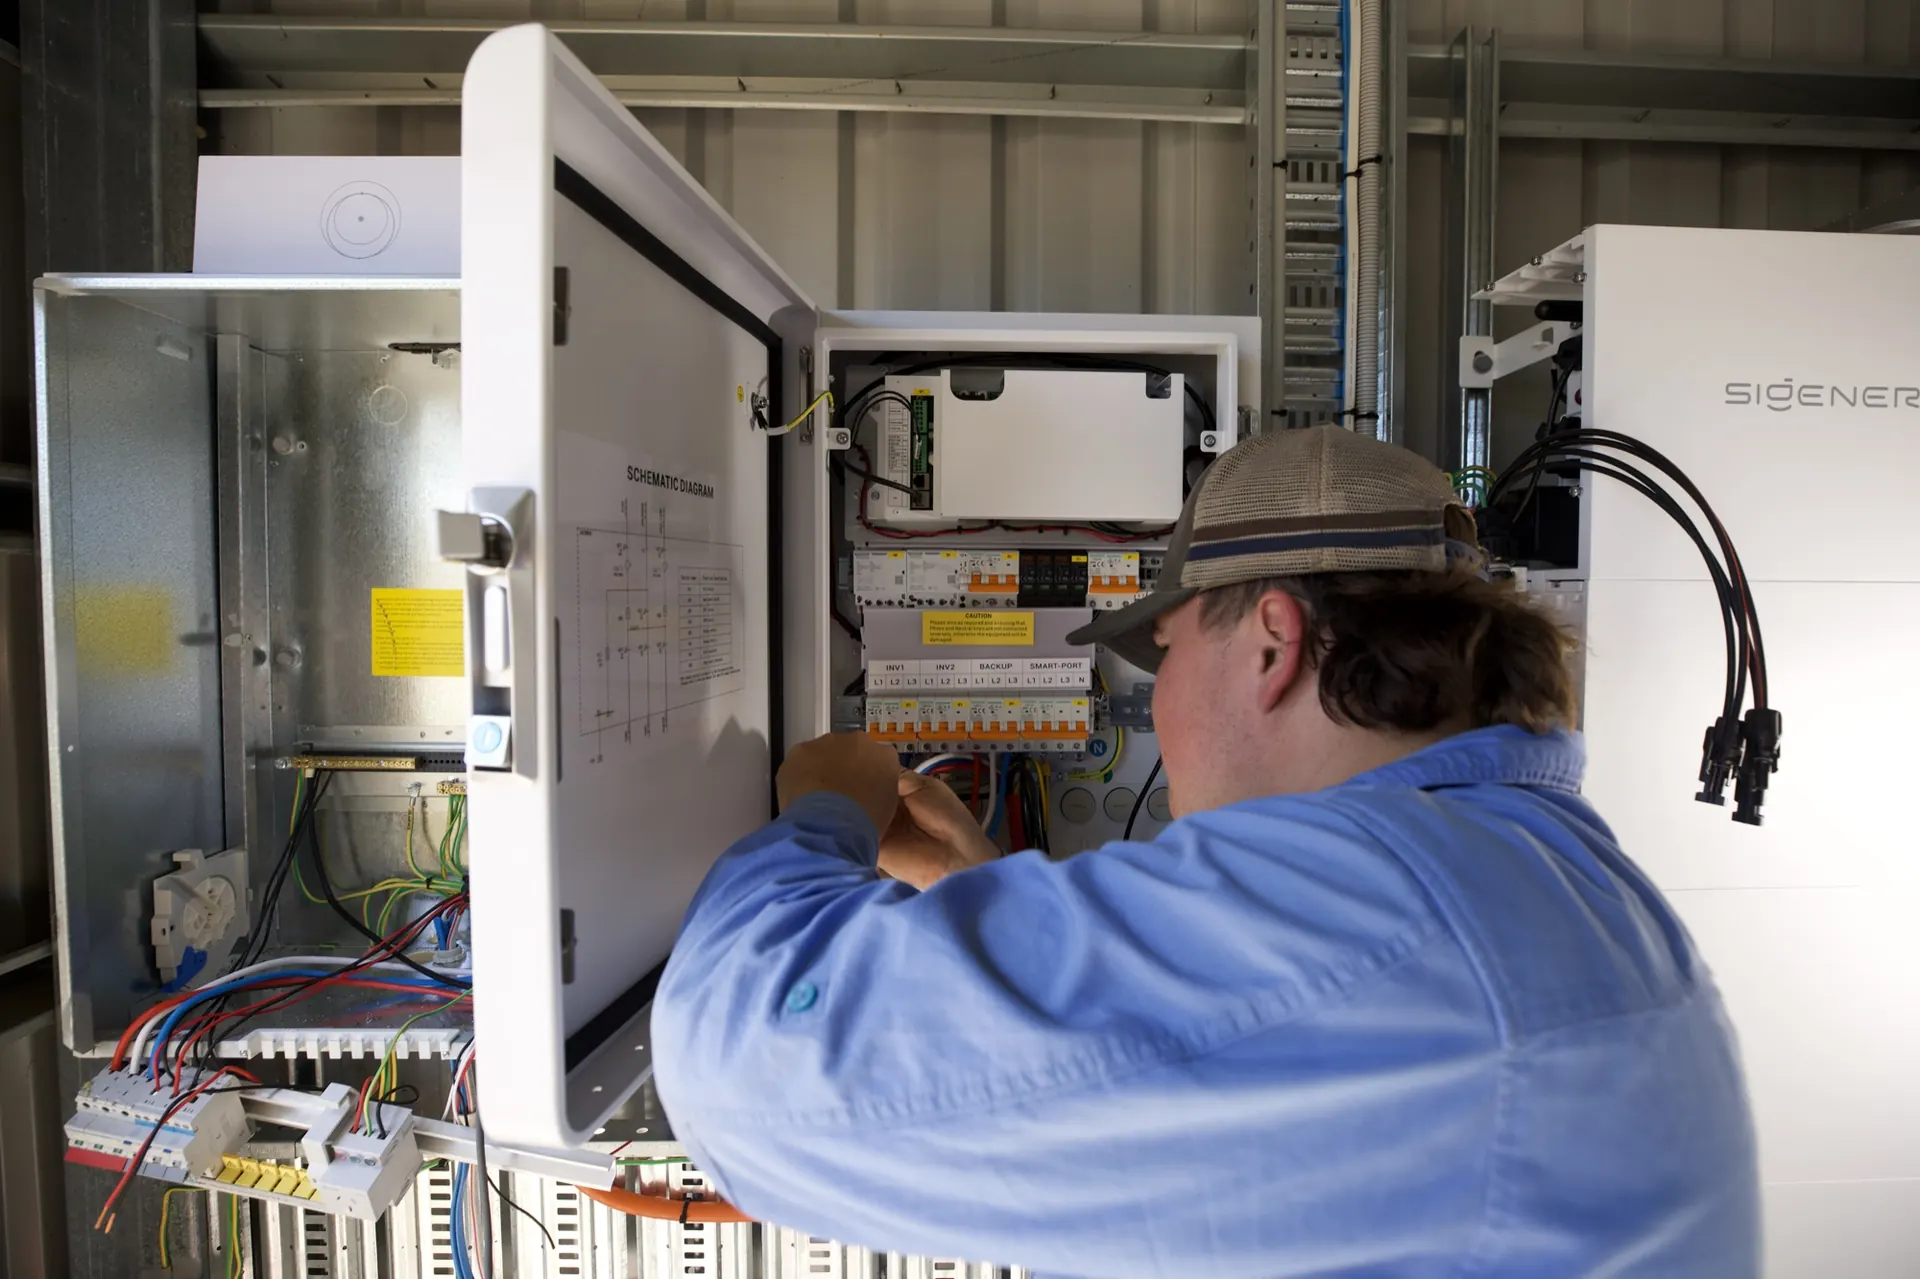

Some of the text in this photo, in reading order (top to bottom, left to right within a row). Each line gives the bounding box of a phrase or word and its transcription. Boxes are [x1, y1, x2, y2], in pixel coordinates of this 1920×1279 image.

[626, 465, 715, 500] SCHEMATIC DIAGRAM
[1029, 662, 1083, 670] SMART-PORT
[1093, 742, 1104, 754] N
